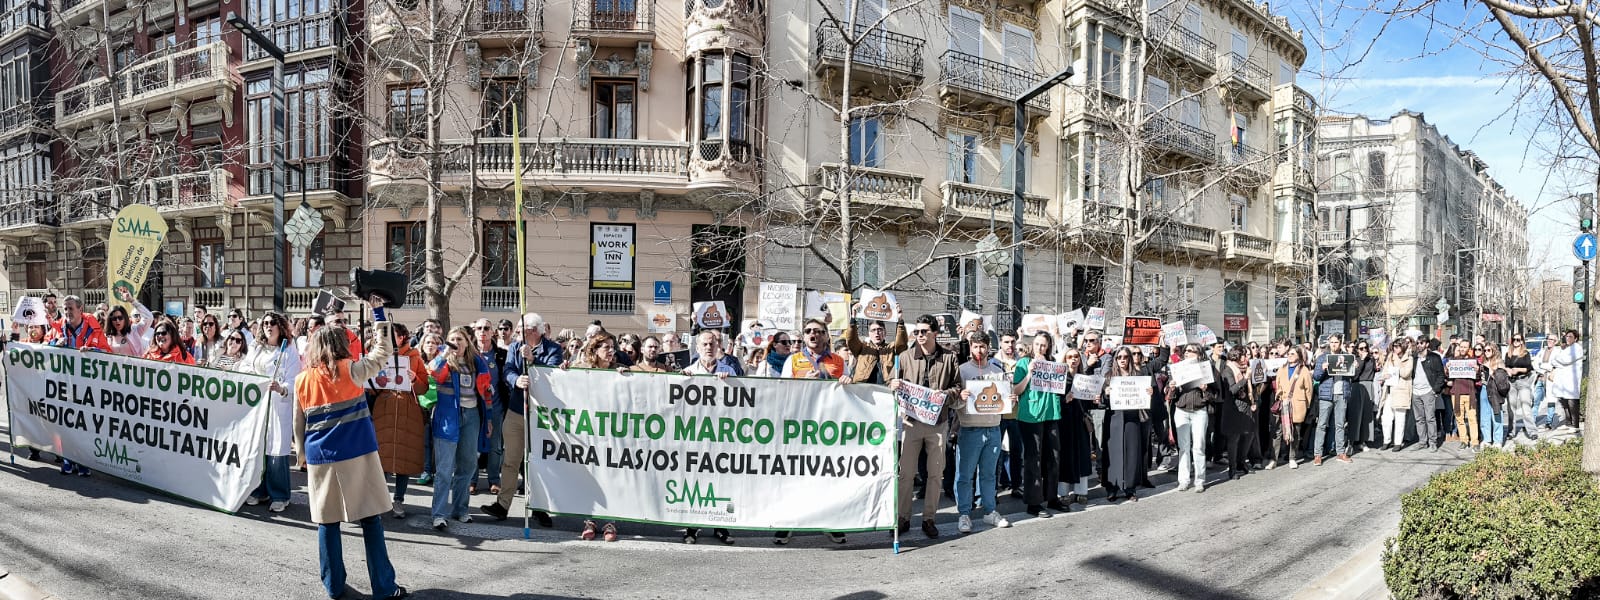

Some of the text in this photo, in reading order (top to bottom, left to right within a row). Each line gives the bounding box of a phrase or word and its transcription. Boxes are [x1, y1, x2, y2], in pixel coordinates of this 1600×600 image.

[117, 217, 160, 237] SMA
[136, 246, 145, 256] de
[597, 240, 628, 248] WORK
[117, 245, 135, 276] Sindicato
[604, 253, 622, 261] INN
[133, 256, 150, 284] Granada
[658, 284, 667, 294] A
[1126, 318, 1160, 328] SE VENDE
[10, 349, 262, 407] POR UN ESTATUTO PROPIO
[1032, 370, 1065, 382] PROPIO
[45, 379, 209, 431] DE LA PROFESIÓN
[668, 384, 756, 407] POR UN
[897, 390, 942, 413] PROPIO
[28, 397, 241, 468] MÉDICA Y FACULTATIVA
[536, 406, 886, 446] ESTATUTO MARCO PROPIO
[94, 437, 138, 466] SMA
[541, 439, 880, 478] PARA LAS/OS FACULTATIVAS/OS
[665, 478, 731, 509] SMA
